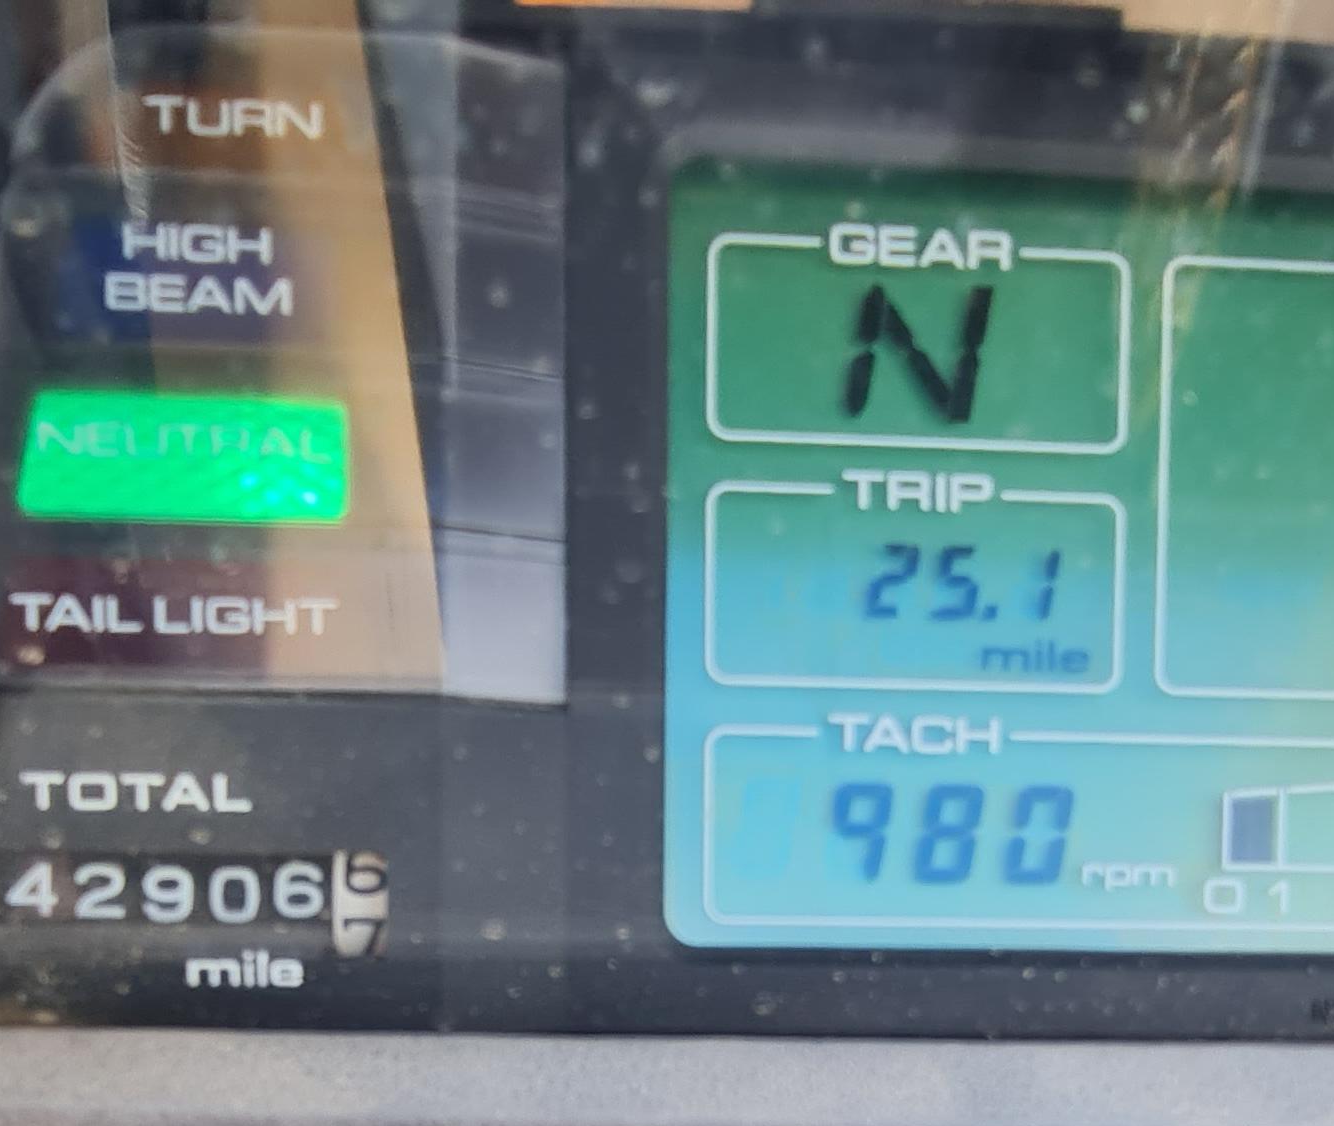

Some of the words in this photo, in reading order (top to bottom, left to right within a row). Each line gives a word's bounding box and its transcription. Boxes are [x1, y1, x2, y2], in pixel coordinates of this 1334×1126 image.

[143, 95, 325, 139] TURN
[121, 223, 273, 264] HIGH
[828, 223, 1013, 271] GEAR
[104, 272, 293, 316] BEAM
[842, 284, 994, 423] N
[37, 421, 333, 464] NEUTRAL
[841, 469, 995, 512] TRIP
[863, 543, 1061, 621] 25.1
[9, 592, 143, 635] TAIL
[154, 595, 337, 636] LIGHT
[981, 638, 1089, 673] mile
[827, 712, 1001, 755] TACH
[19, 771, 253, 814] TOTAL
[831, 782, 1074, 885] 980
[1082, 862, 1176, 892] rpm
[1204, 877, 1244, 914] 0
[1269, 881, 1290, 913] 1
[186, 950, 304, 988] mile
